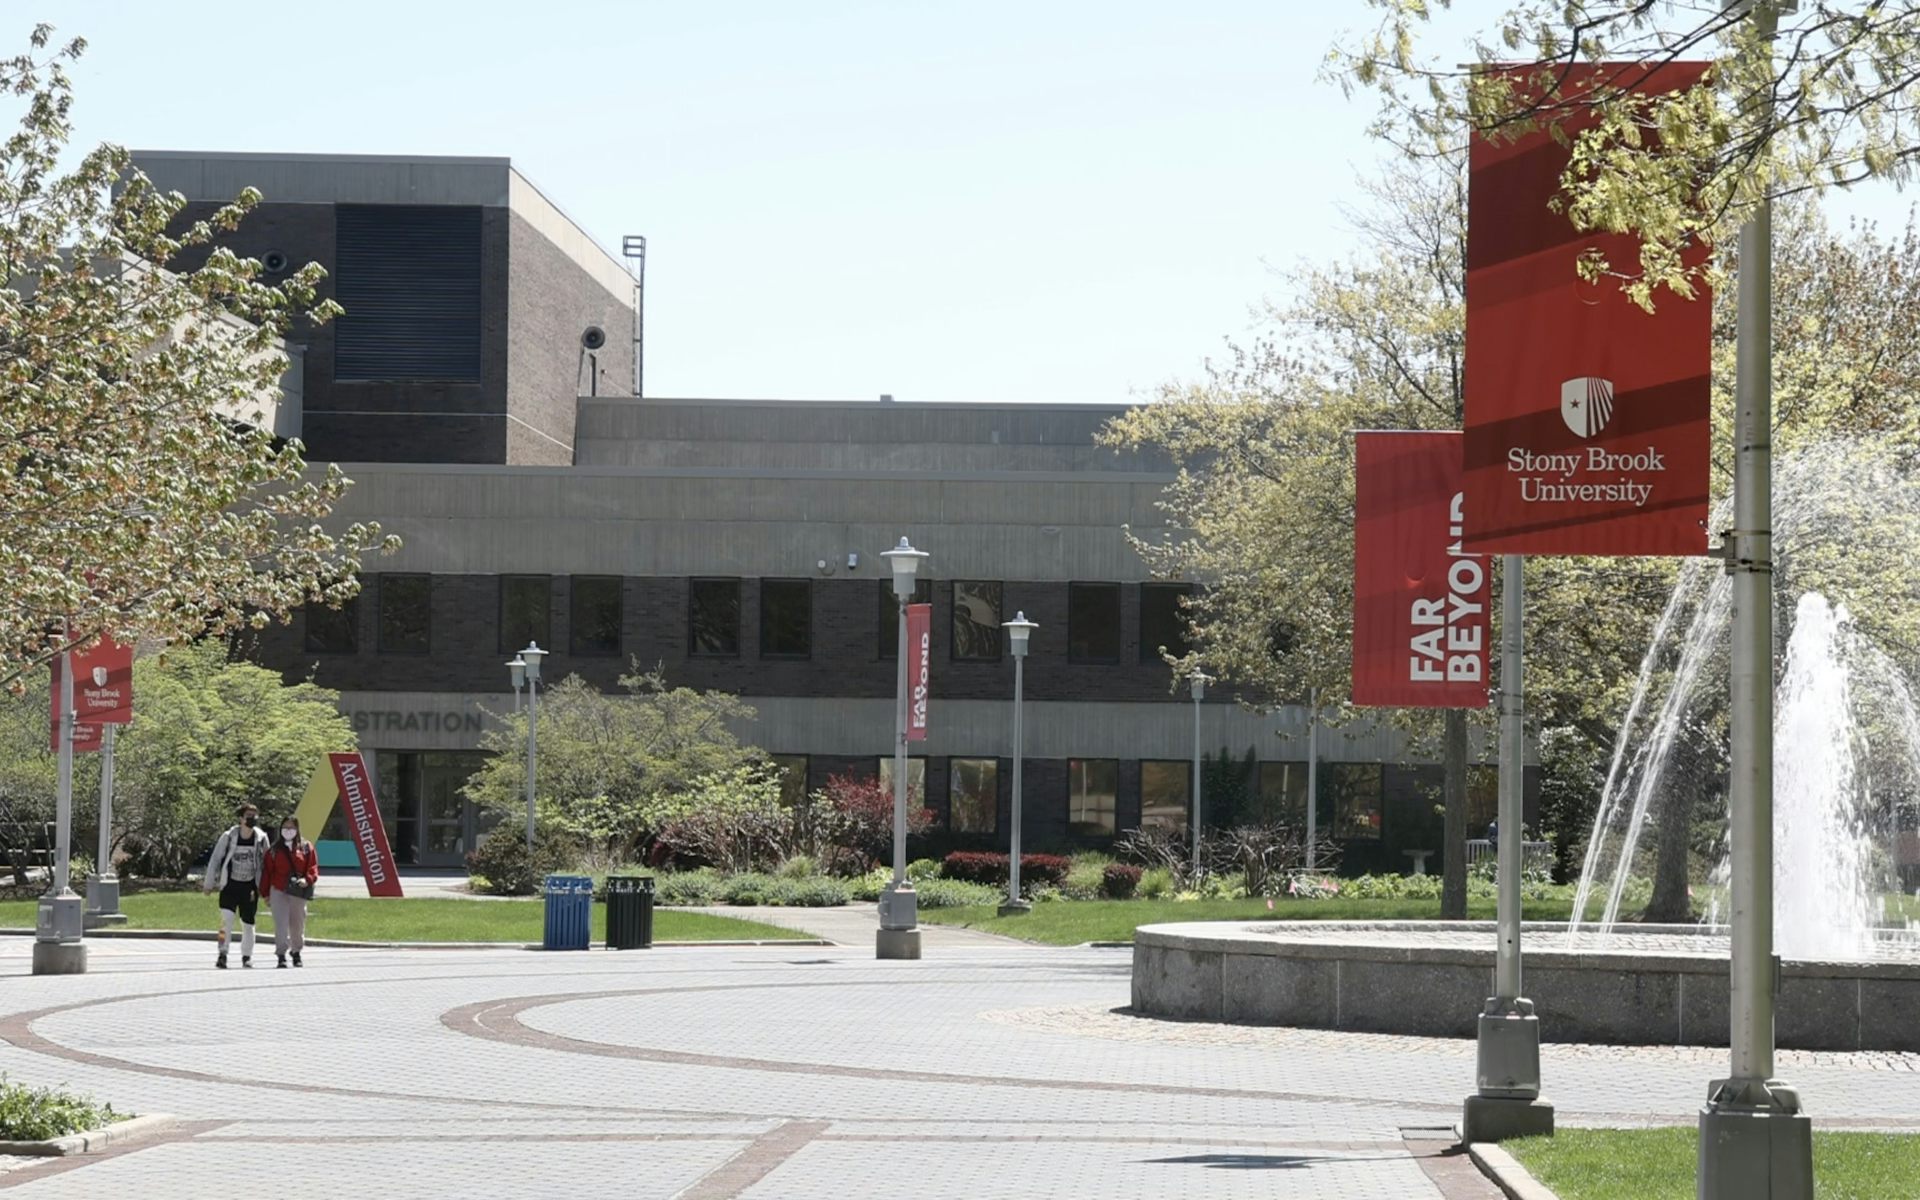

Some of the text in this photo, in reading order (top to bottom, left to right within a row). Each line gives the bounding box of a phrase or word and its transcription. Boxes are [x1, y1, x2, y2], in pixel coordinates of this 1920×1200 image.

[1507, 446, 1666, 477] Stony Brook
[1519, 478, 1653, 507] University
[1410, 597, 1446, 681] FAR
[101, 688, 121, 698] Brook
[919, 633, 929, 728] BEYOND
[88, 699, 118, 708] University
[353, 710, 482, 733] STRATION
[339, 762, 387, 885] Administration
